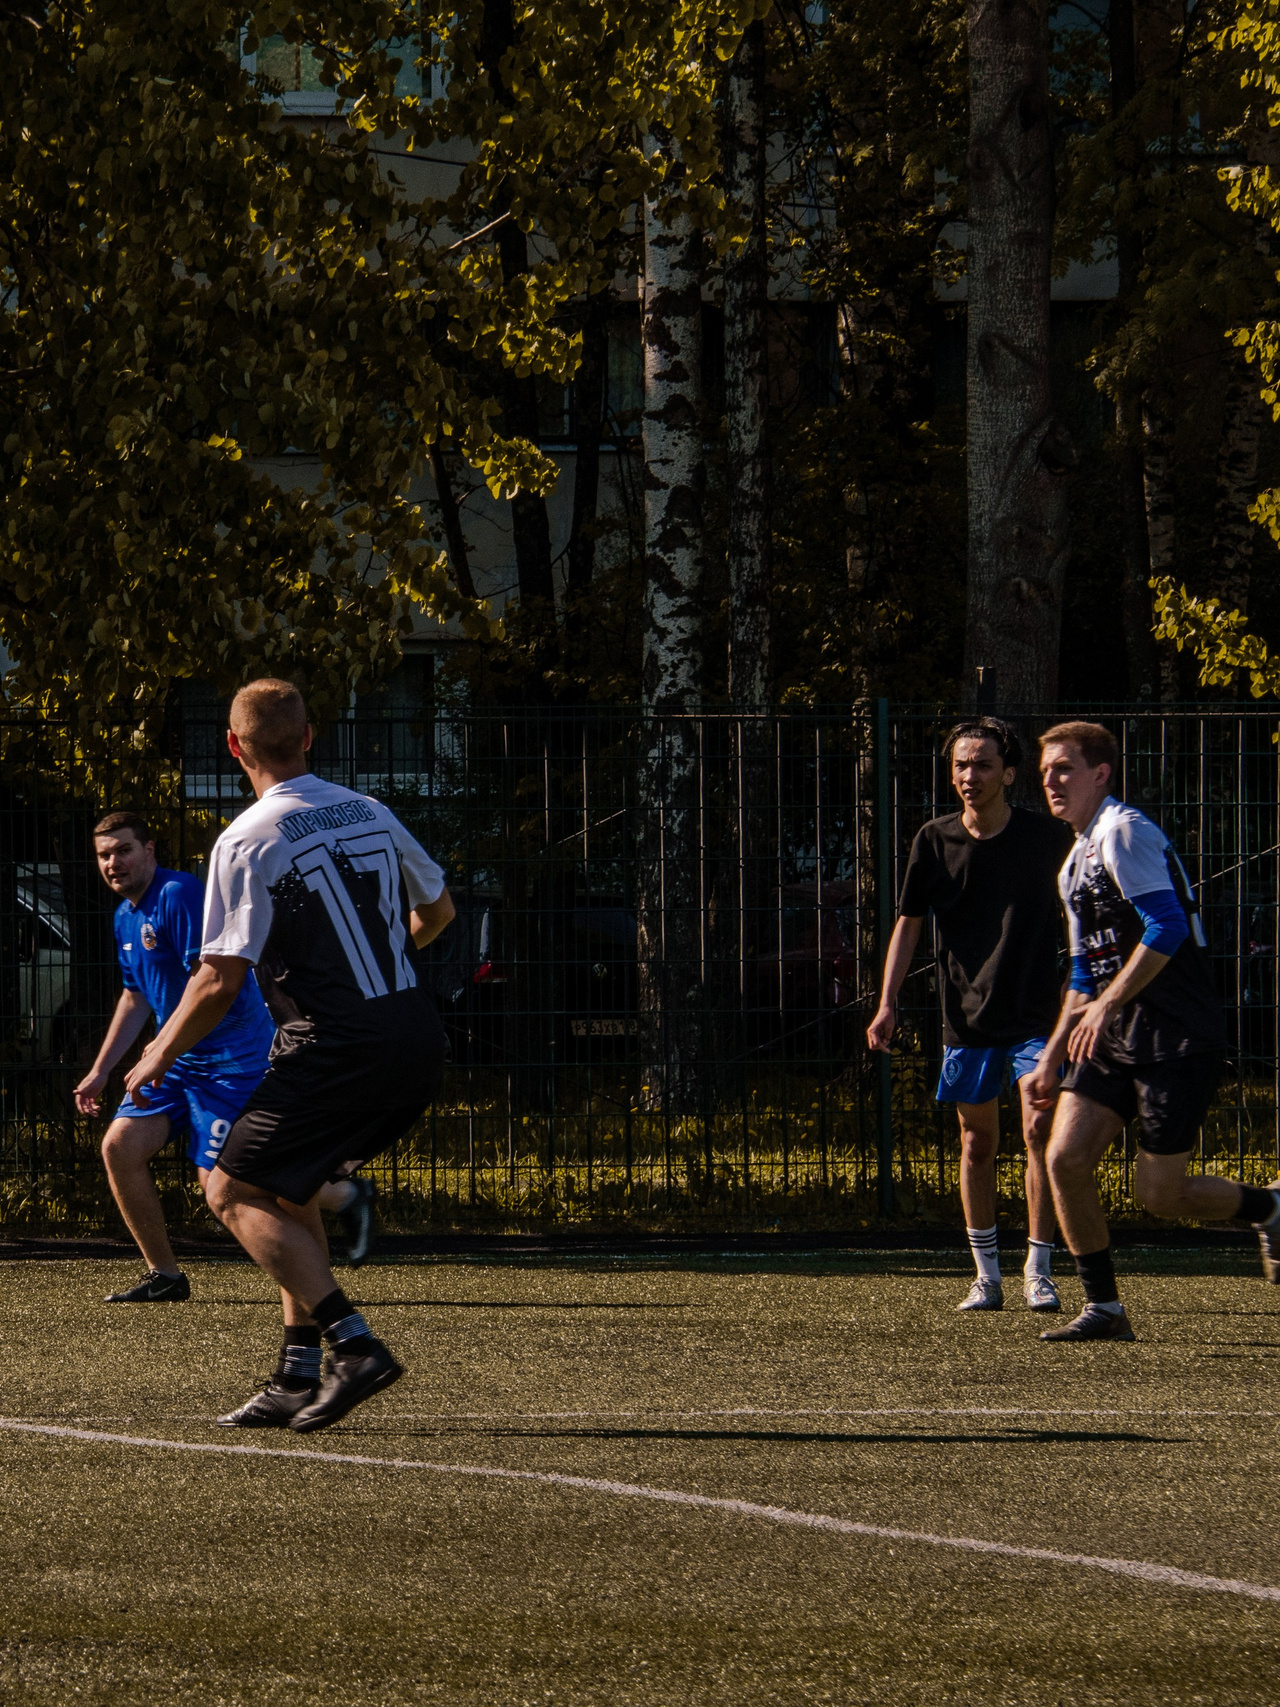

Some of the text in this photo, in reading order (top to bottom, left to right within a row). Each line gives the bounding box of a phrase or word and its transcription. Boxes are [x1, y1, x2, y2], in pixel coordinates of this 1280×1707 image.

[276, 800, 376, 843] МИРОЛЮБОВ
[291, 831, 418, 1000] 17
[208, 1118, 233, 1149] 9
